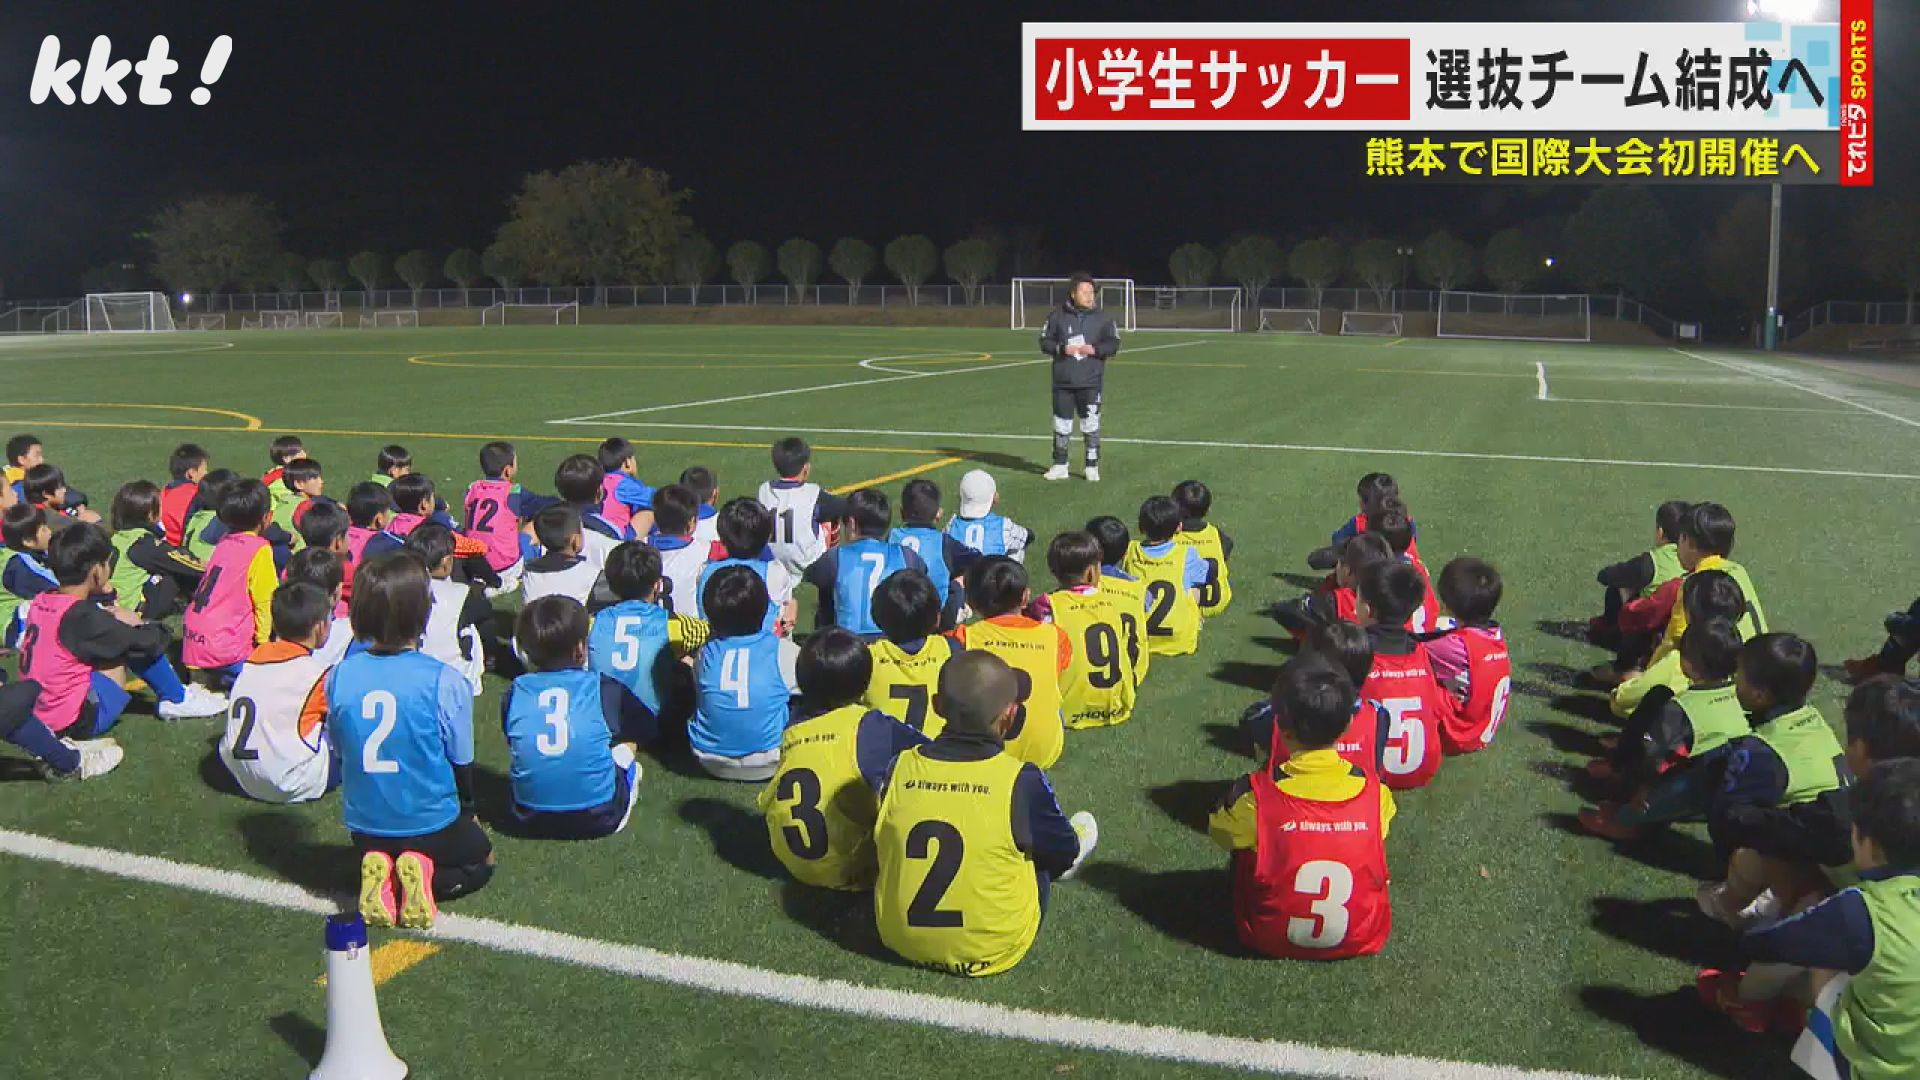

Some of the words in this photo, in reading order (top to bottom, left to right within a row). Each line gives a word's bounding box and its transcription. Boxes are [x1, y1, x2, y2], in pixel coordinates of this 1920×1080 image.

[464, 497, 499, 532] 12
[1145, 579, 1176, 636] 2
[610, 615, 641, 671] 5
[1085, 622, 1122, 689] 9
[719, 648, 750, 709] 4
[231, 696, 259, 760] 2
[361, 689, 399, 774] 2
[536, 687, 570, 757] 3
[1382, 696, 1426, 775] 5
[776, 768, 829, 860] 3
[917, 780, 948, 792] always
[950, 782, 970, 793] with
[1300, 820, 1331, 832] always
[905, 819, 965, 928] 2
[1286, 860, 1354, 949] 3
